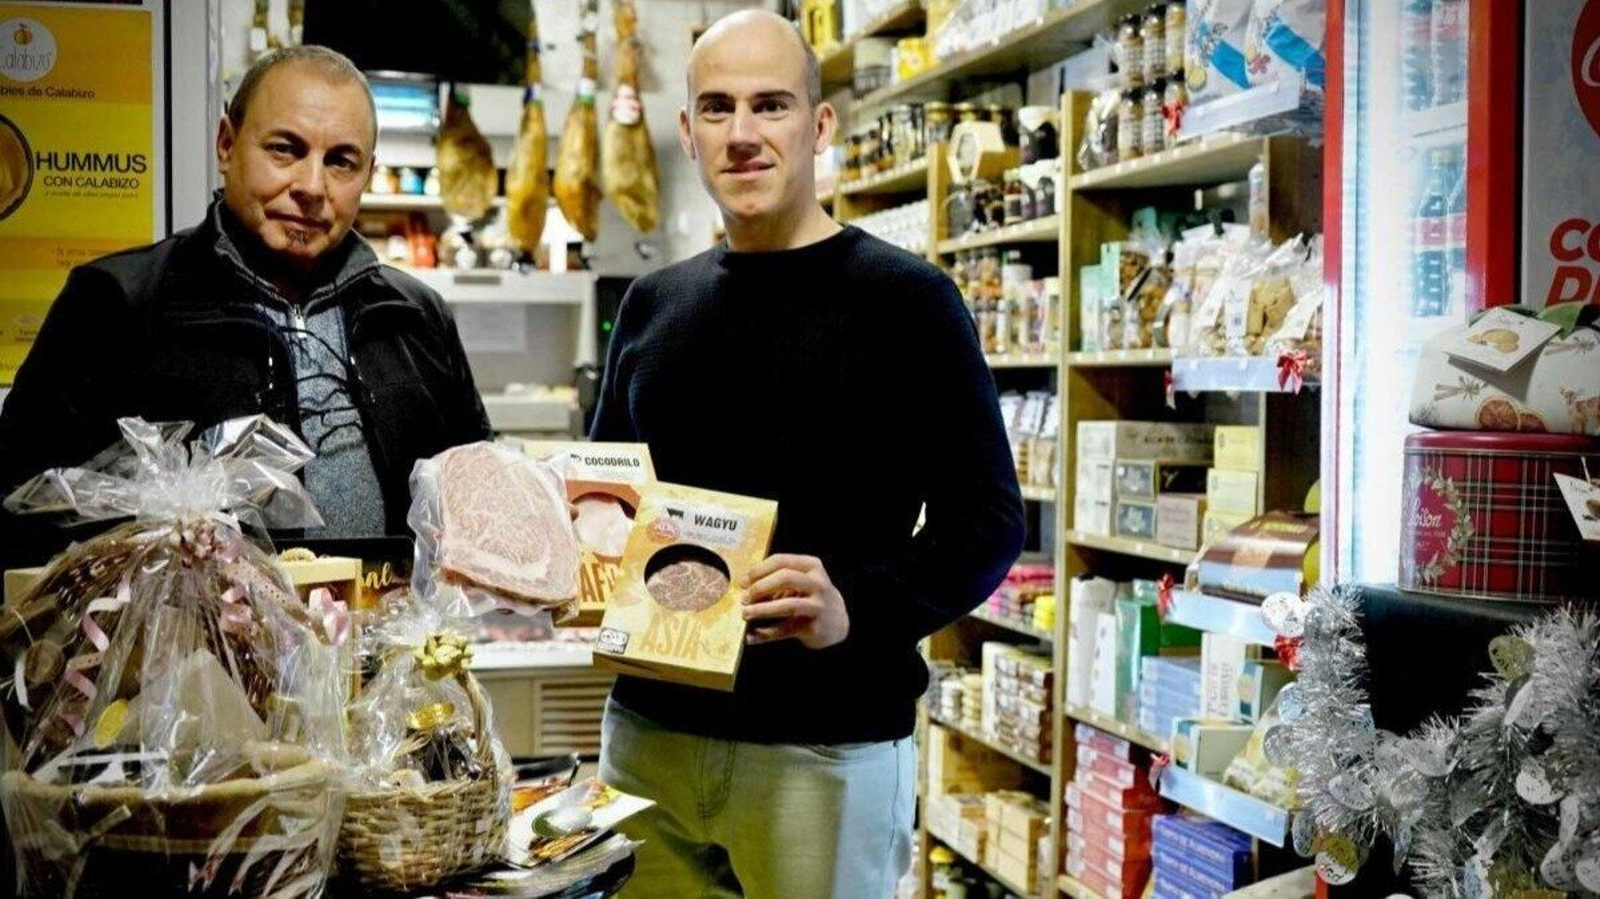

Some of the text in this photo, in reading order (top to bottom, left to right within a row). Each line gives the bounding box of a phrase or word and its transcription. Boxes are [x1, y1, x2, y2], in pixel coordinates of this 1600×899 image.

[45, 86, 96, 99] Calabizo
[36, 151, 147, 174] HUMMUS
[43, 175, 140, 189] CON CALABIZO
[584, 455, 640, 468] COCODRILO
[694, 513, 738, 532] WAGYU
[639, 611, 703, 661] ASIA
